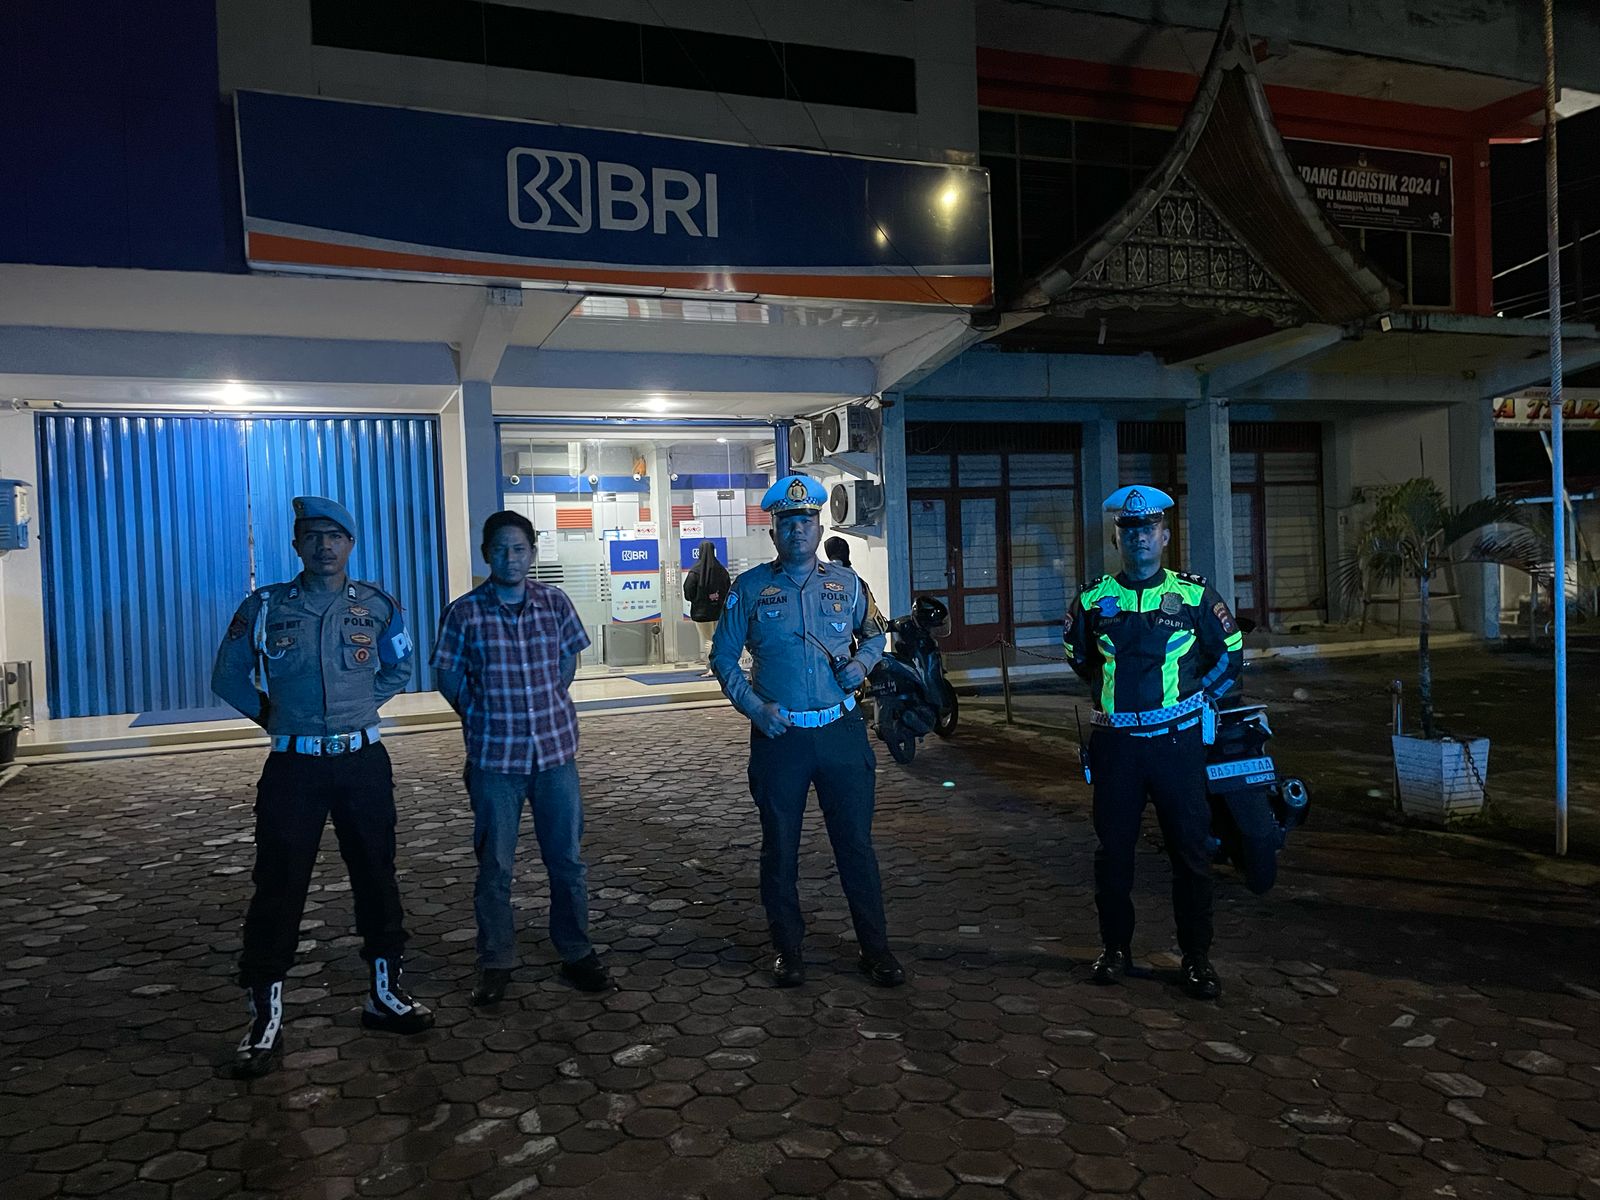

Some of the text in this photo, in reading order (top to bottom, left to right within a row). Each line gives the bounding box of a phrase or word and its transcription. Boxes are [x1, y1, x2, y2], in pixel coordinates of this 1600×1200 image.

[1298, 165, 1338, 186] DANG
[1341, 169, 1398, 192] LOGISTIK
[1400, 176, 1432, 195] 2024
[597, 161, 718, 238] BRI
[1317, 187, 1409, 208] KPU KABUPATEN AGAM
[632, 550, 648, 560] BRI
[622, 580, 651, 590] ATM
[757, 595, 788, 606] FAUZAN
[821, 592, 848, 602] POLRI
[344, 617, 374, 628] POLRI
[1158, 618, 1184, 628] POLRI
